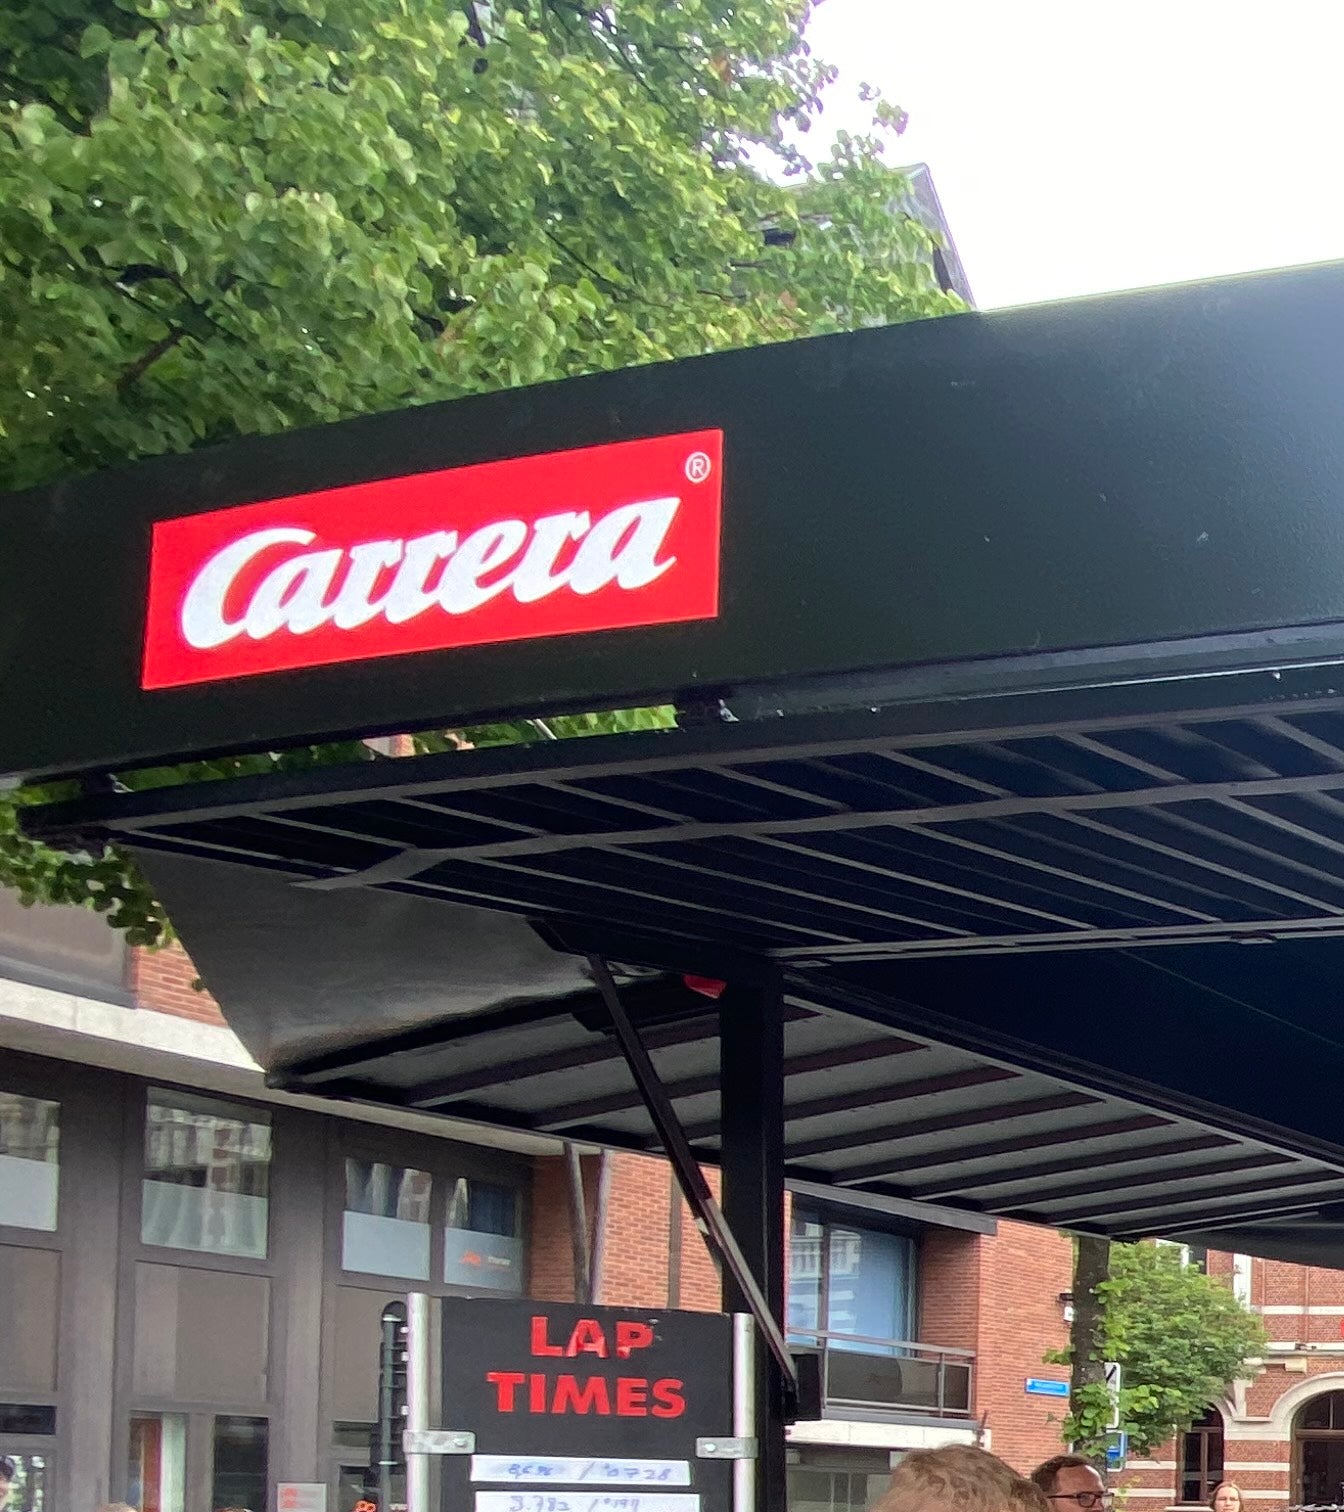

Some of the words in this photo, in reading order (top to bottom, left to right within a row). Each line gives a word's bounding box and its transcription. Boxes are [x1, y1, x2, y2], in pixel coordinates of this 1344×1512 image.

[181, 497, 681, 649] Carrera
[531, 1316, 653, 1358] LAP
[486, 1372, 686, 1418] TIMES
